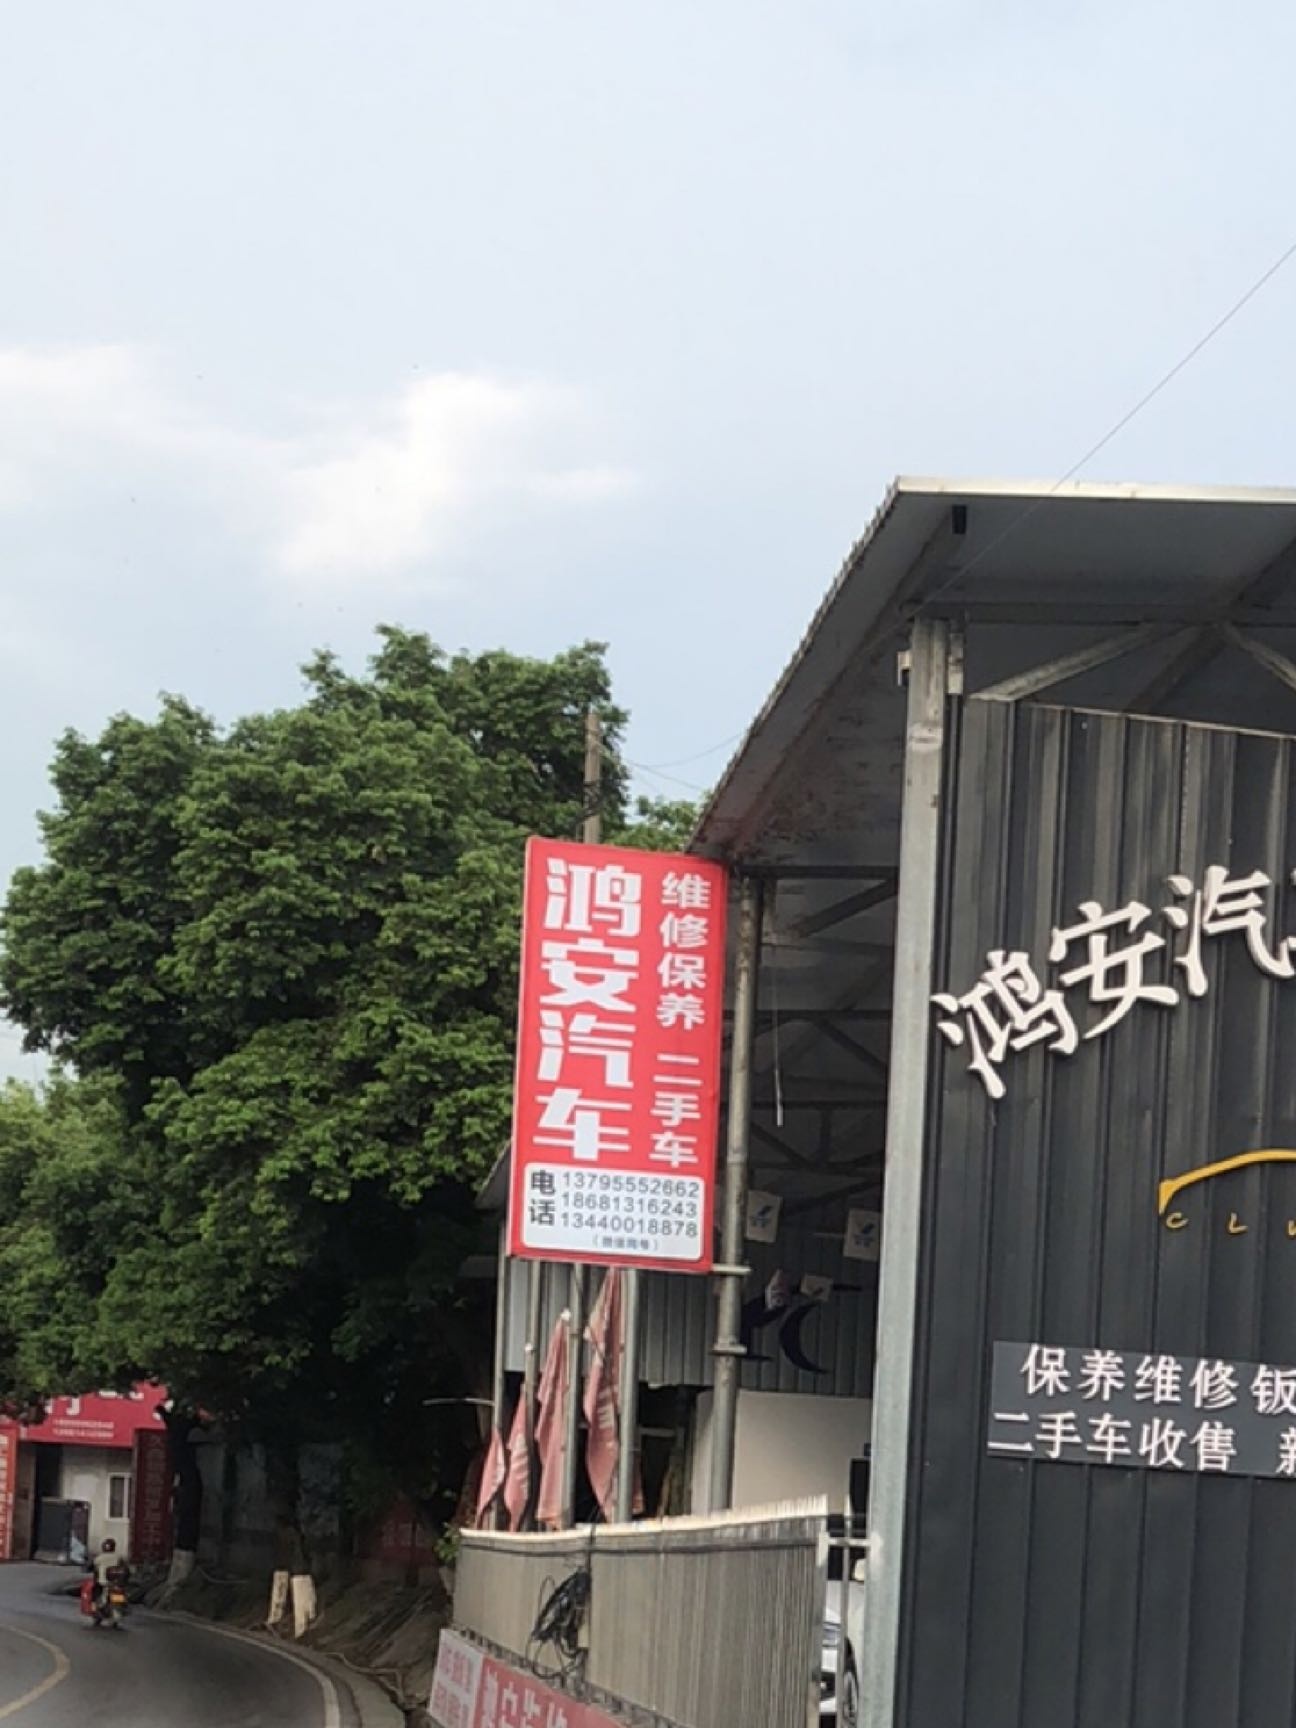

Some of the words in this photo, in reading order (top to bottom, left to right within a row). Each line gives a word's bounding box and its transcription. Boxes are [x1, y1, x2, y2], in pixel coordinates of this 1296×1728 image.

[655, 871, 712, 1031] 维修保养
[531, 857, 642, 1161] 鸿安汽车
[649, 1052, 703, 1169] 二手车
[527, 1168, 556, 1229] 电话
[561, 1170, 700, 1199] 13795552662
[561, 1191, 698, 1219] 18681316243
[560, 1211, 699, 1238] 13440018878
[987, 1410, 1238, 1472] 二手车收售
